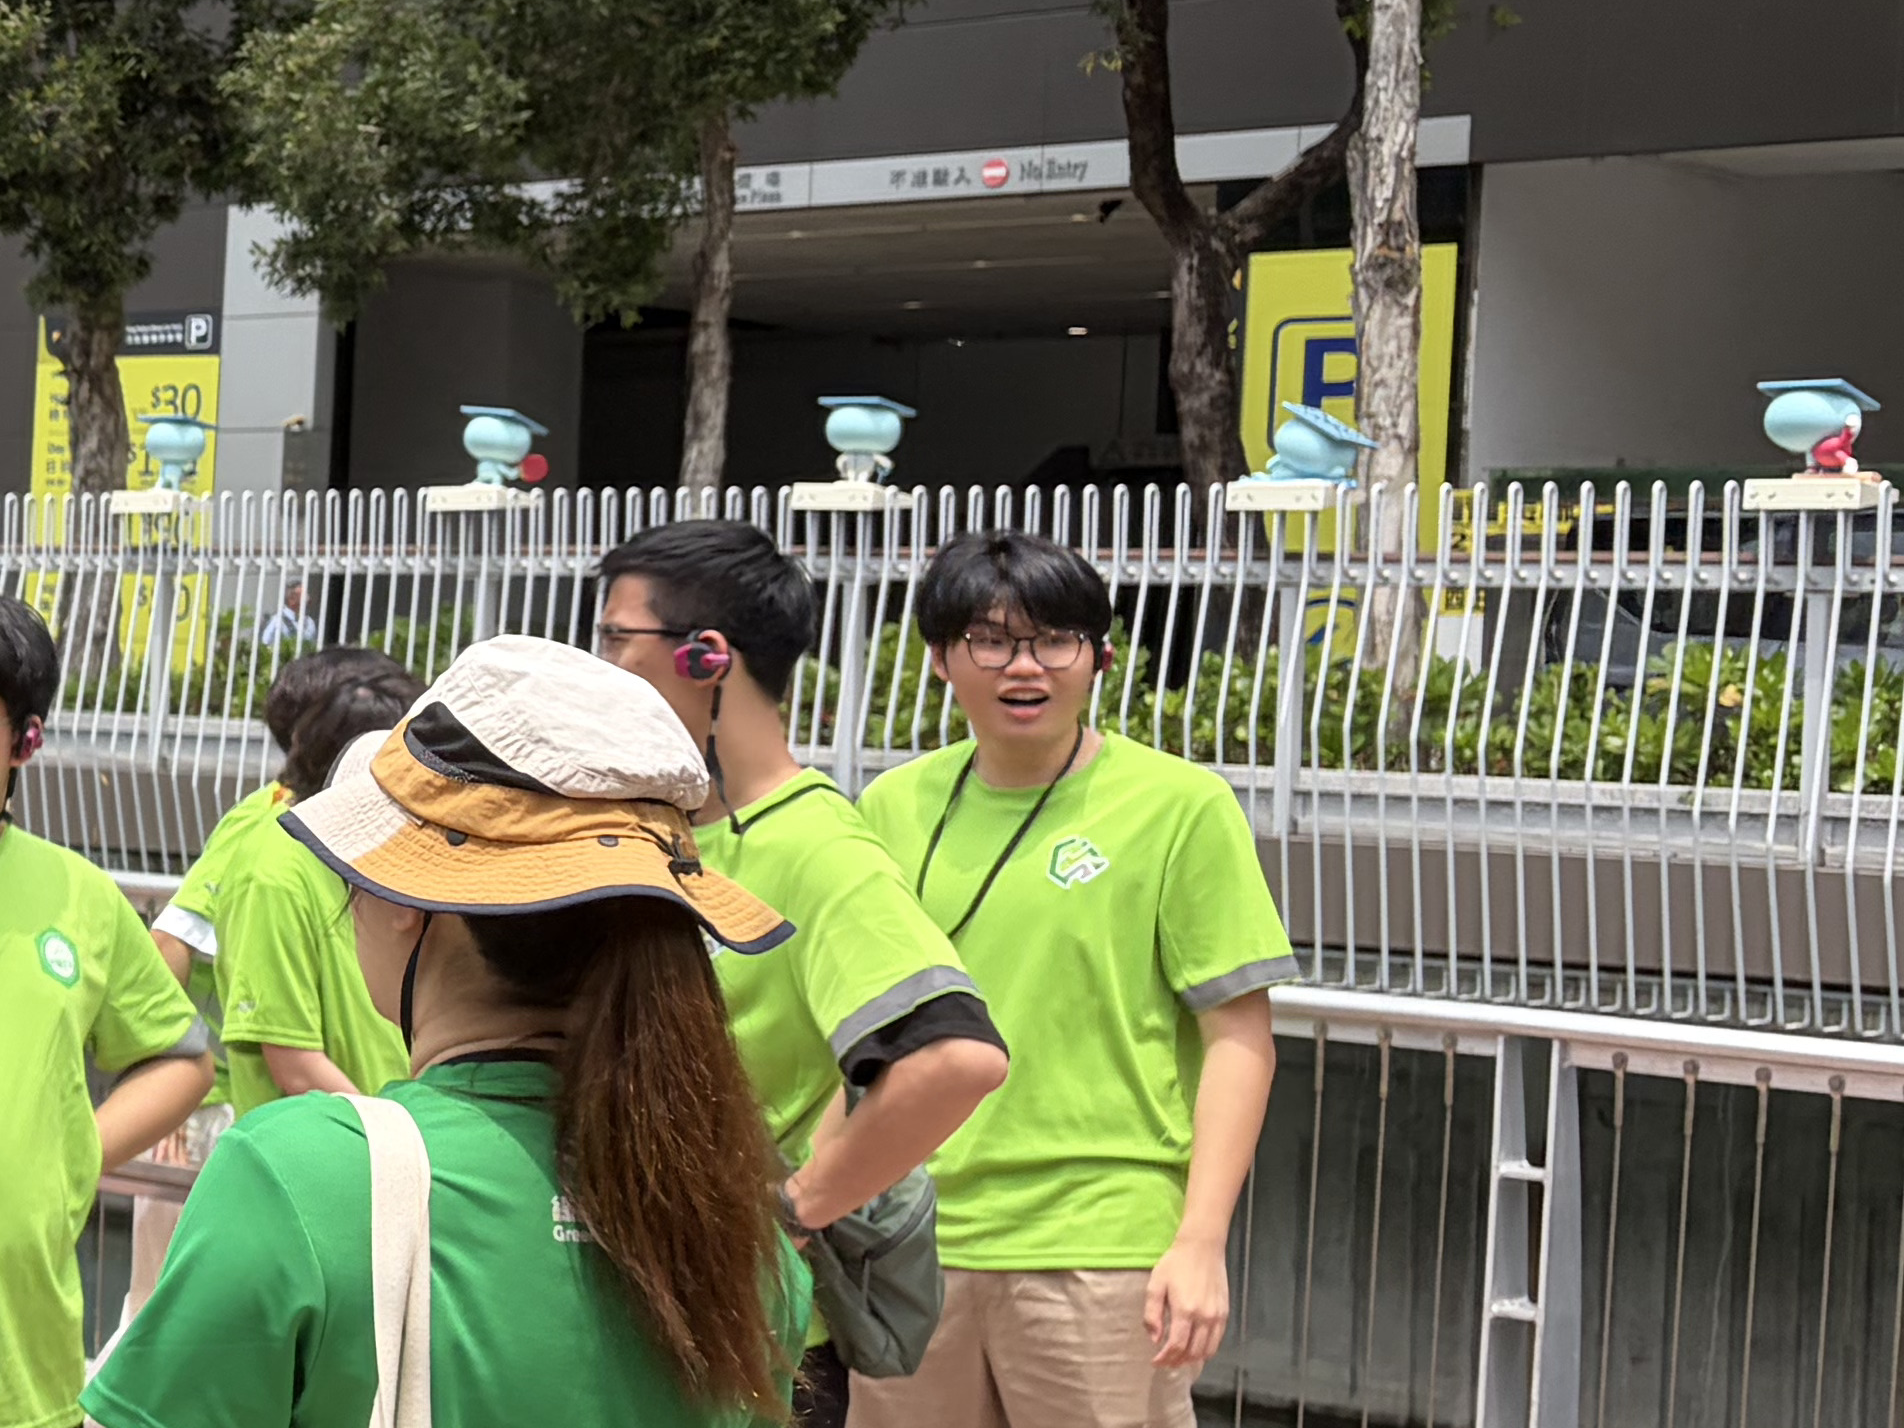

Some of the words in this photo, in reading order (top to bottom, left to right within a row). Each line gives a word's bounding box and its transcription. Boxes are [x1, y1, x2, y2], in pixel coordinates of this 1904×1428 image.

[1019, 159, 1041, 182] No
[1045, 156, 1088, 182] Entry
[151, 383, 202, 421] $30
